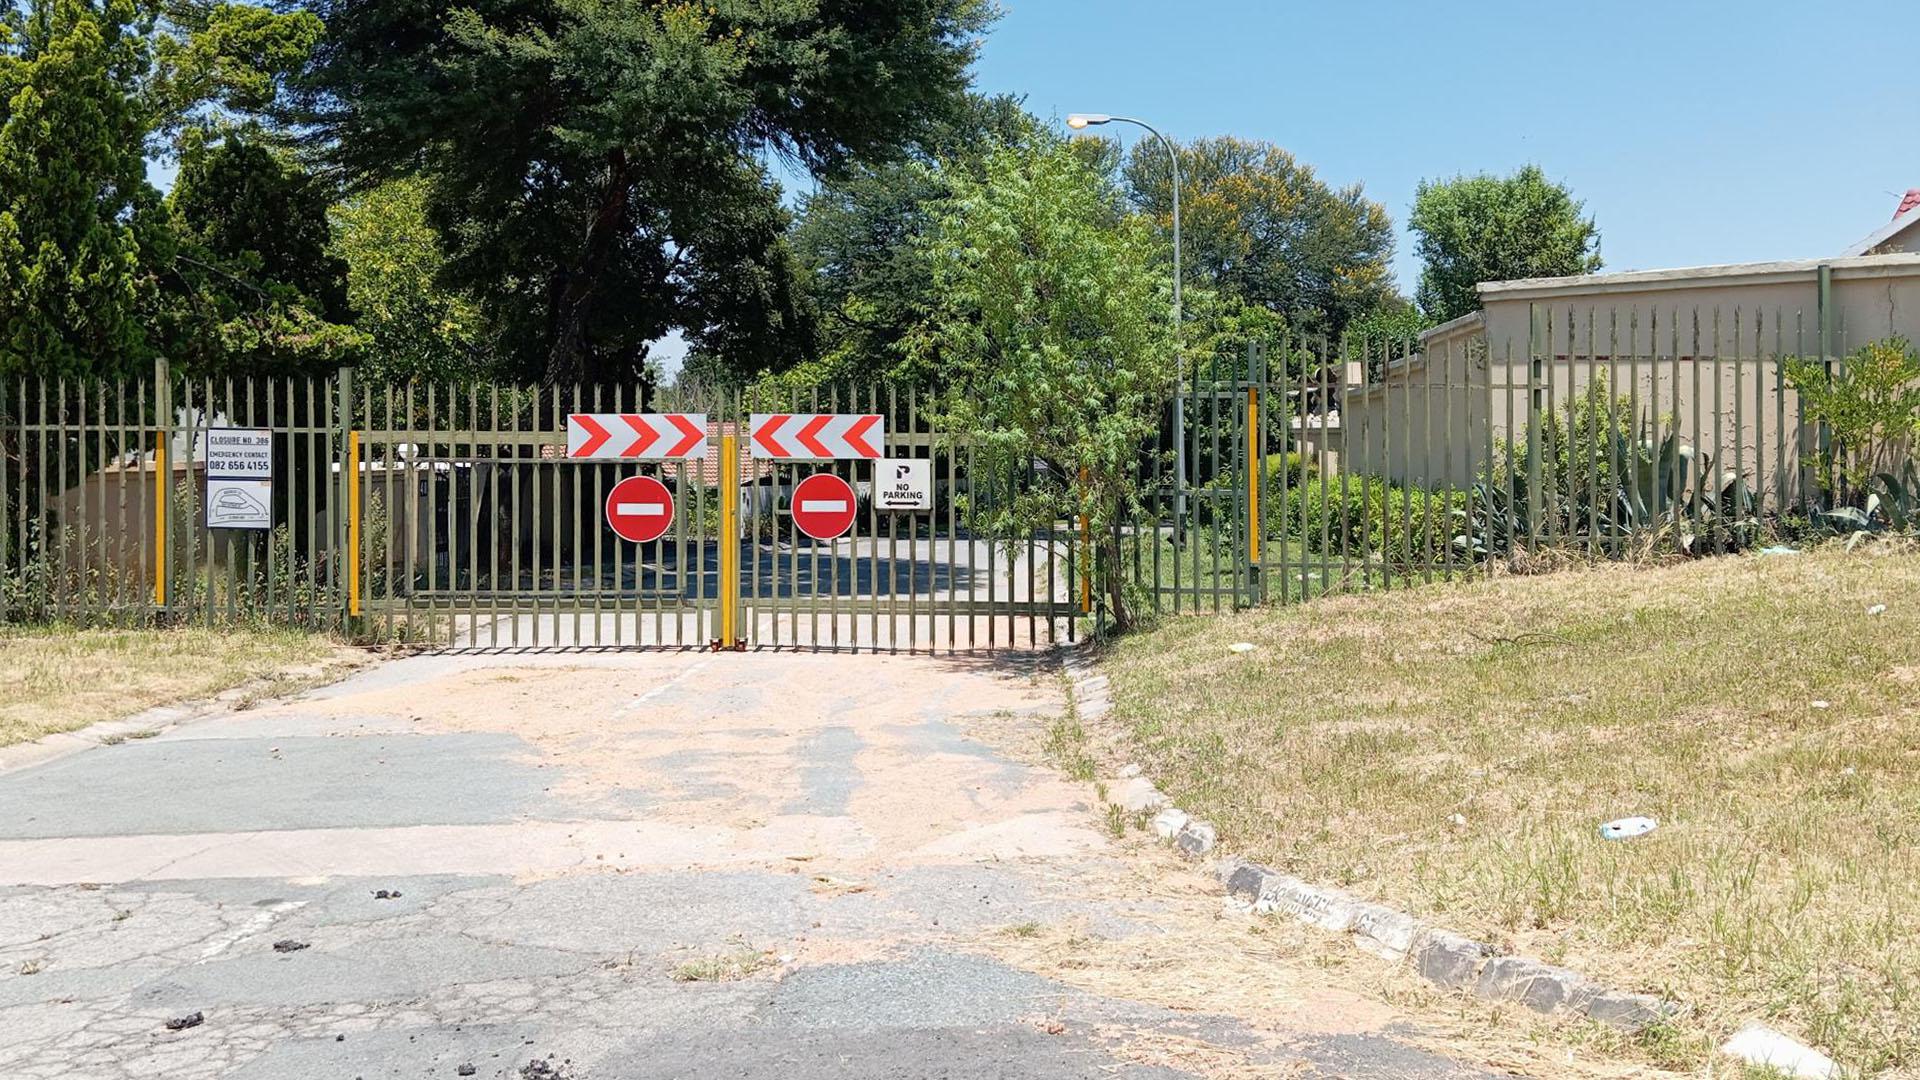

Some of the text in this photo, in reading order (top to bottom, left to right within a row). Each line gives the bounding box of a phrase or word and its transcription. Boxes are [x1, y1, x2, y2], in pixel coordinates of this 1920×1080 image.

[210, 436, 241, 444] CLOSURE
[209, 460, 269, 470] 082 656 4155
[896, 483, 909, 491] NO
[883, 491, 923, 499] PARKING
